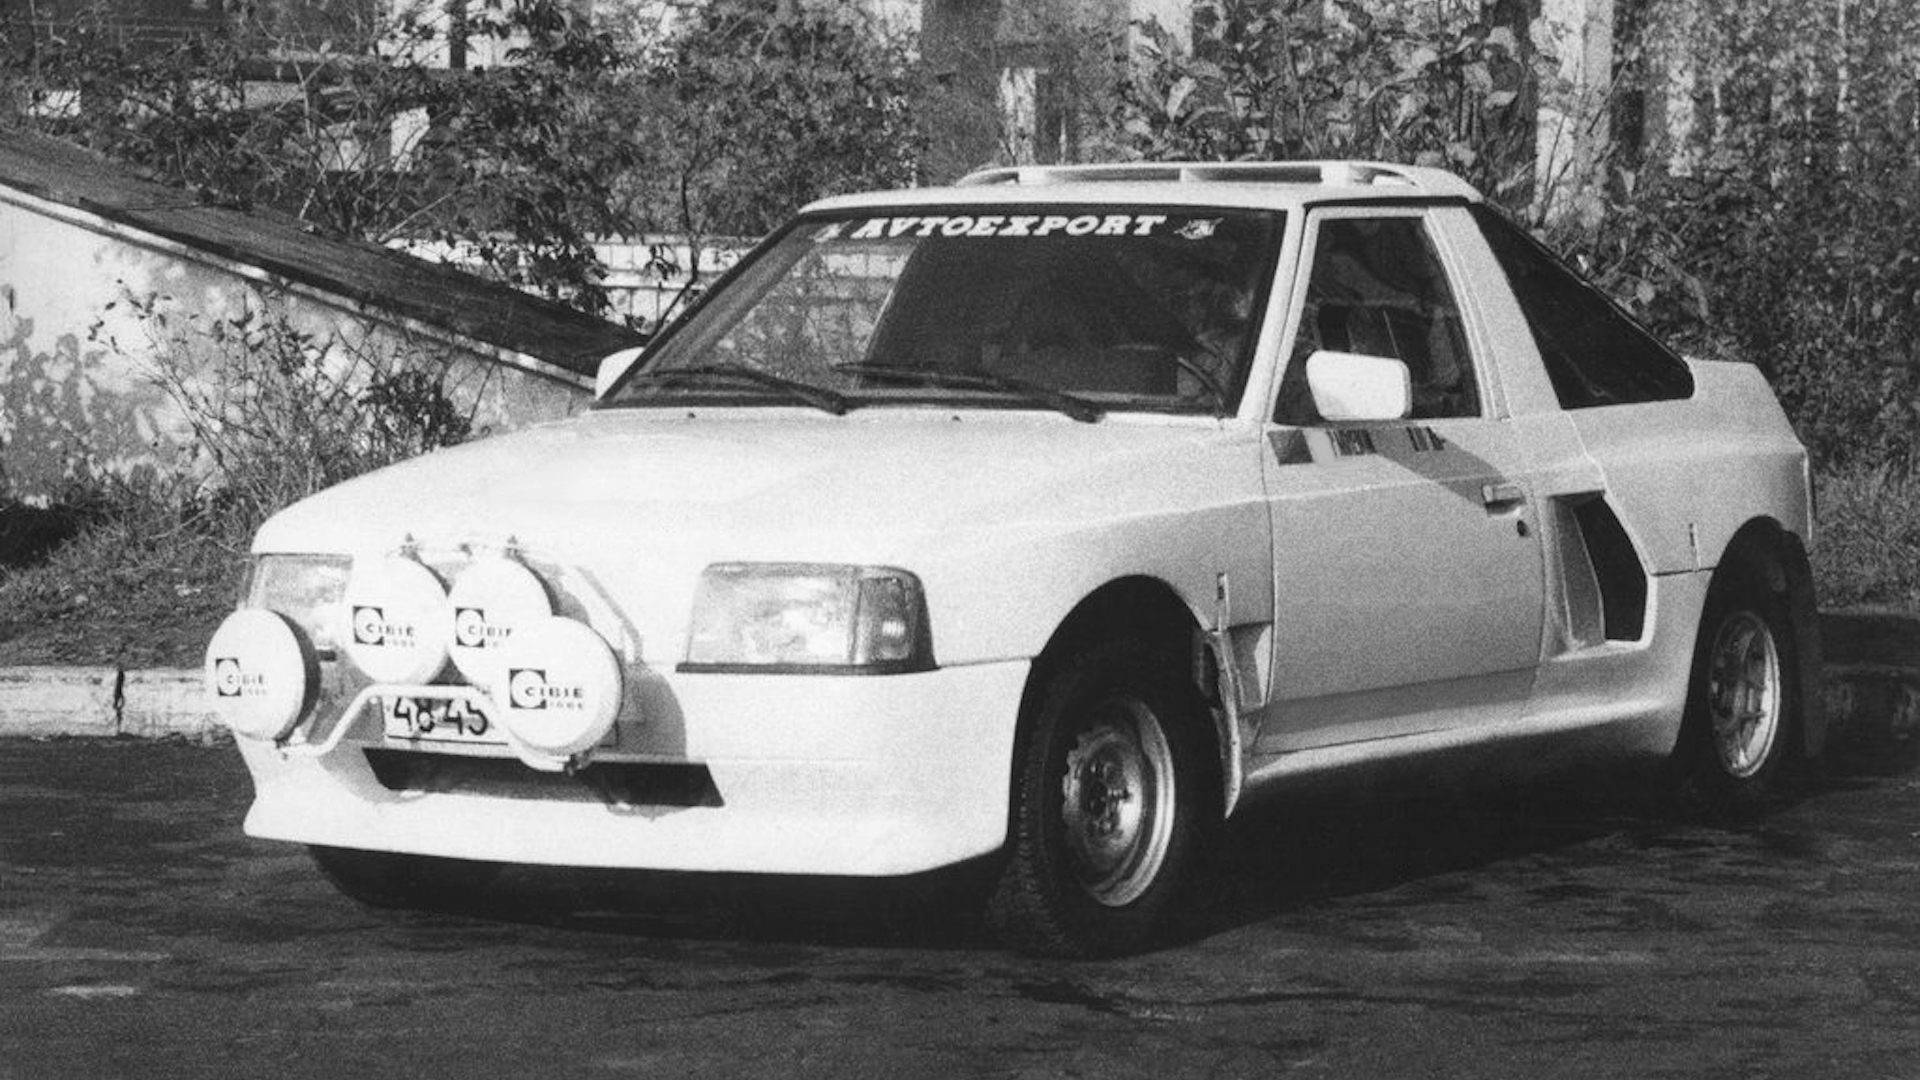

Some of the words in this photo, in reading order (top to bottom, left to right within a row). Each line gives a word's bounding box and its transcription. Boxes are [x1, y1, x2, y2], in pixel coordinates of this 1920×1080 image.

[851, 215, 1167, 238] AVTOEXPORT
[365, 623, 415, 638] CIBIE
[525, 686, 583, 699] CIBIE
